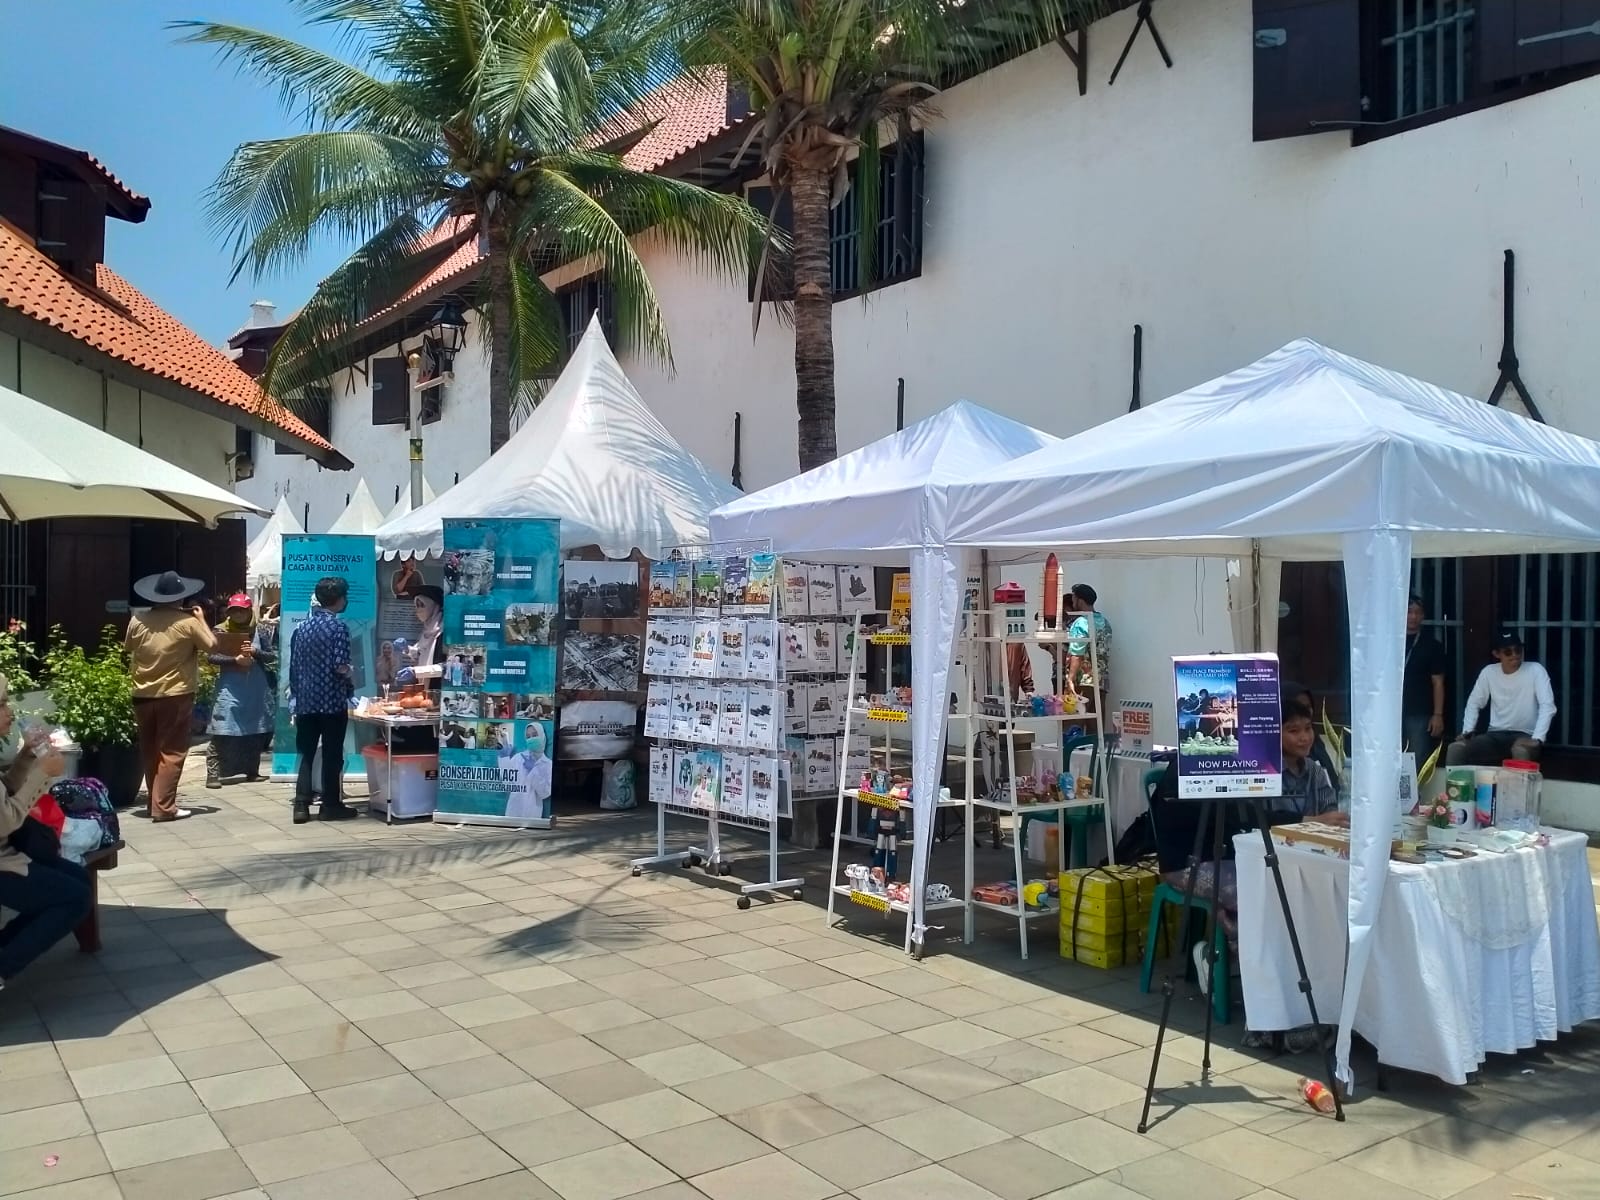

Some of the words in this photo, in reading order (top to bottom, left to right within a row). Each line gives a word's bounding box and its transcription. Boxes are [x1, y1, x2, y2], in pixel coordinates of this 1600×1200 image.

[288, 554, 313, 562] PUSAT
[315, 554, 364, 563] KONSERVASI
[287, 563, 315, 571] CAGAR
[316, 564, 350, 572] BUDAYA
[1122, 711, 1150, 724] FREE
[1198, 760, 1220, 769] NOW
[1222, 760, 1258, 768] PLAYING
[440, 766, 500, 780] CONSERVATION
[502, 769, 519, 782] ACT
